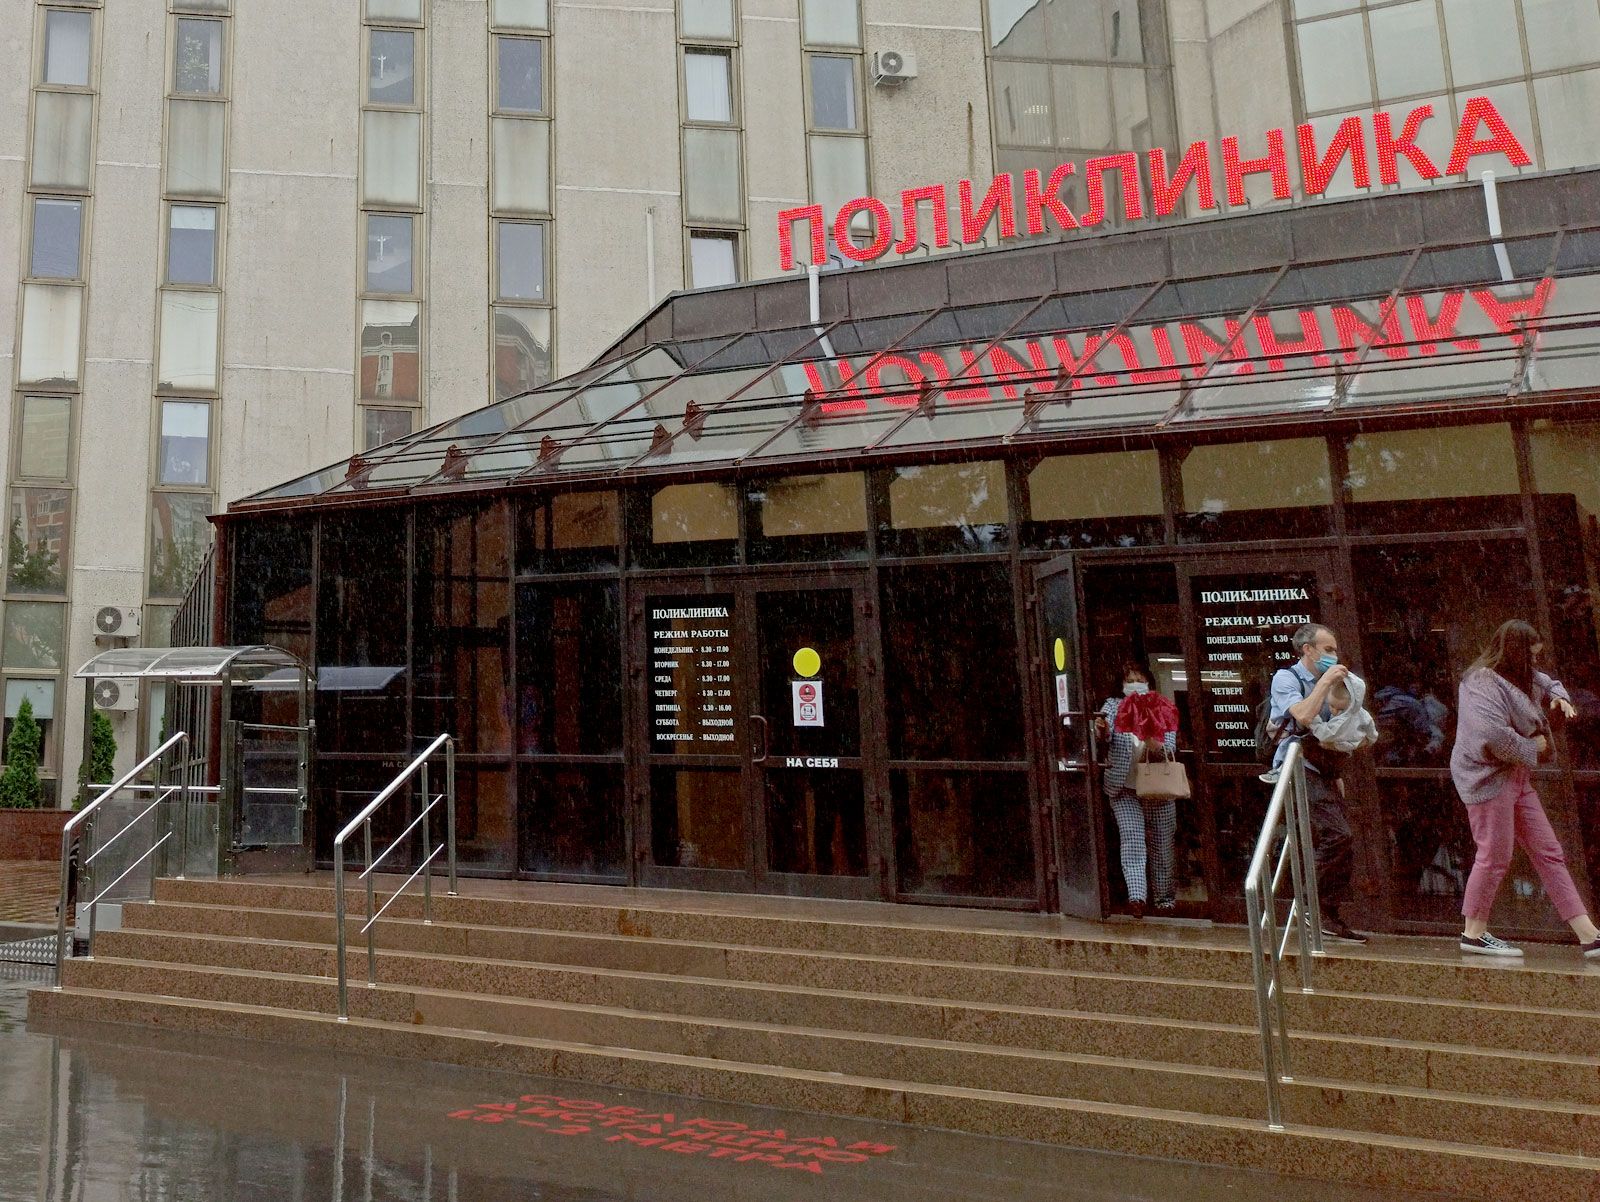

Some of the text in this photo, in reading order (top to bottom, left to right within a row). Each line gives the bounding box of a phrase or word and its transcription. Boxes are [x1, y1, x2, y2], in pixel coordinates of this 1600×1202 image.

[777, 96, 1531, 271] ПОЛИКЛИНИКА
[1202, 588, 1309, 603] ПОЛИКЛИНИКА
[653, 607, 728, 619] ПОЛИКЛИНИКА
[1205, 615, 1310, 626] РЕЖИМ РАБОТЫ
[654, 630, 728, 639] РЕЖИМ РАБОТЫ
[1207, 636, 1262, 644] ПОНЕДЕЛЬНИК
[1208, 653, 1243, 661] ВТОРНИК
[1275, 652, 1290, 660] 8.30
[1214, 705, 1249, 713] ПЯТНИЦА
[1216, 722, 1248, 730] СУББОТА
[786, 758, 838, 768] НА СЕБЯ
